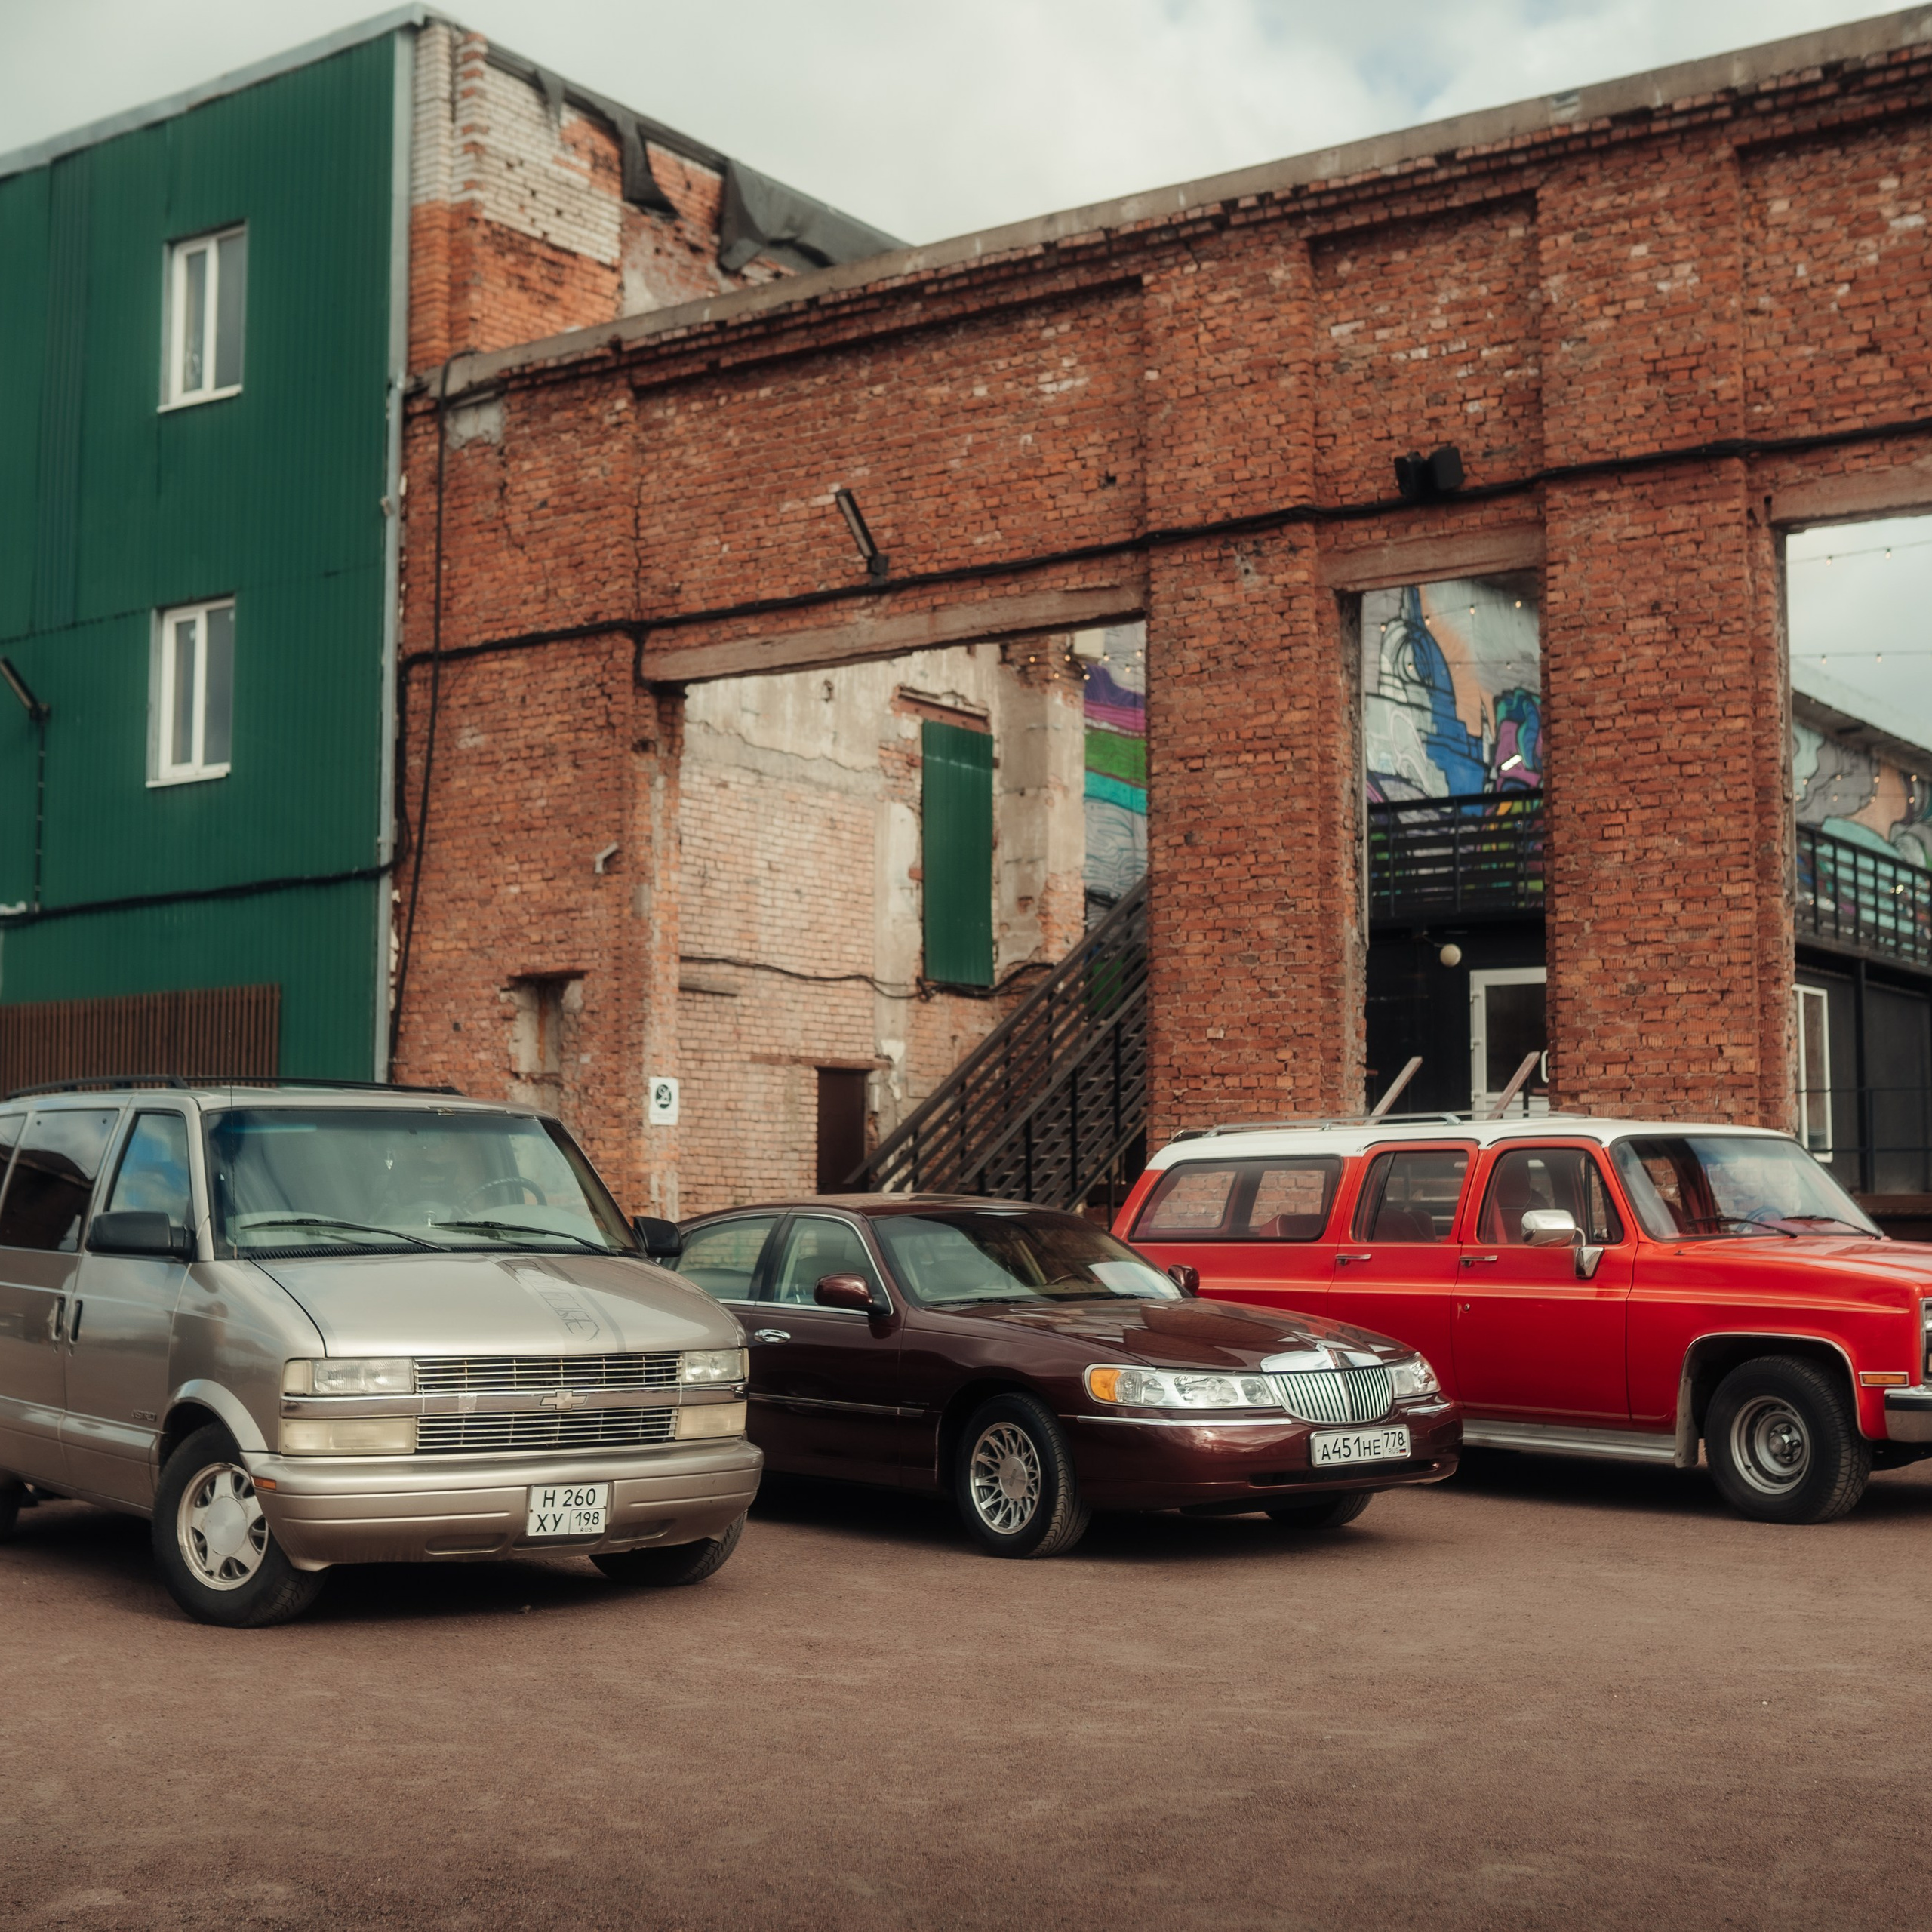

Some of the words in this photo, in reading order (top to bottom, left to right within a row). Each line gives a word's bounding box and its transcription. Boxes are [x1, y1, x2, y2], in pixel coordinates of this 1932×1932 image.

[1321, 1436, 1381, 1460] А451НЕ
[1383, 1431, 1404, 1448] 778
[562, 1488, 596, 1507] 260
[575, 1511, 600, 1526] 198
